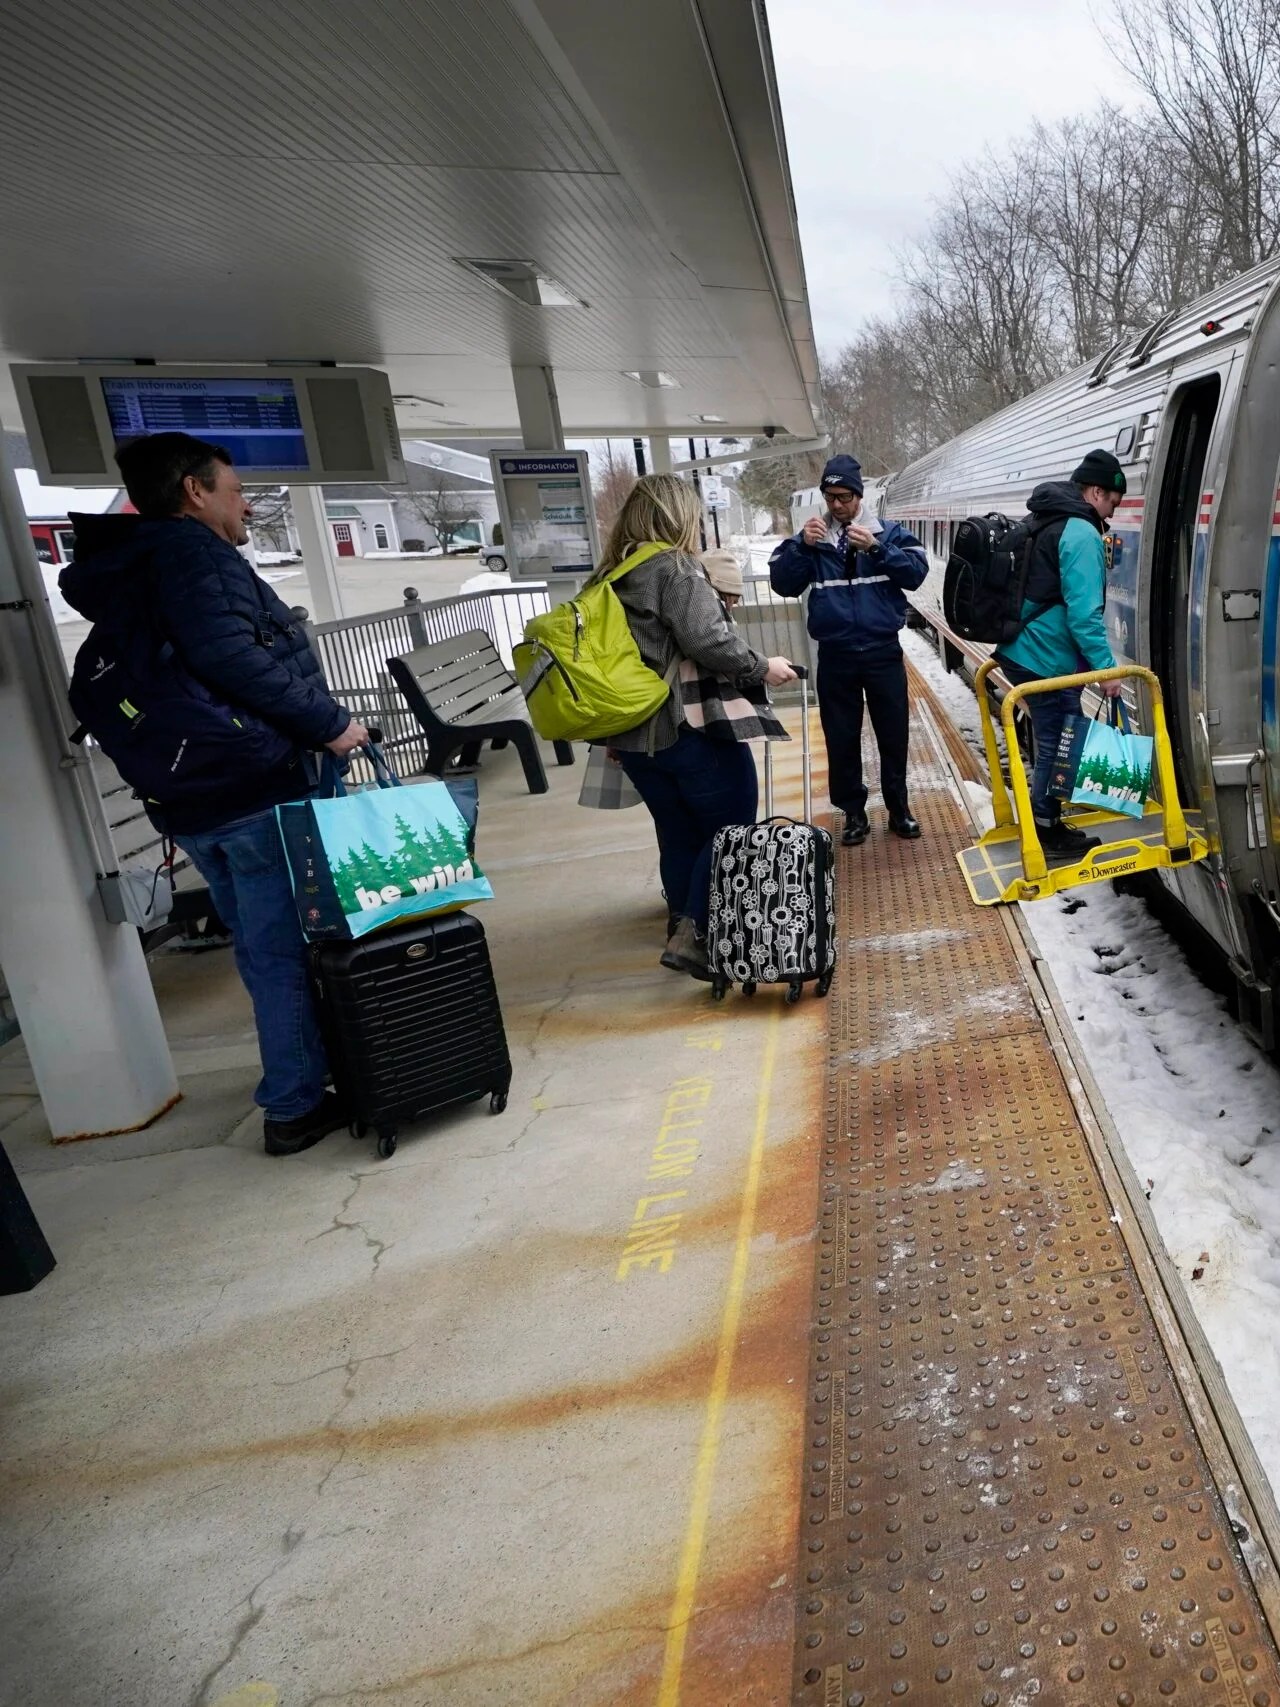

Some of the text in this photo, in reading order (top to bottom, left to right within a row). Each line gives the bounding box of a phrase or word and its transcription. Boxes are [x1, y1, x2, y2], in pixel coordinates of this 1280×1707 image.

[136, 380, 206, 391] Information
[518, 463, 576, 471] INFORMATION
[1082, 776, 1103, 794] be
[1108, 784, 1142, 803] wild
[354, 859, 475, 911] be wild
[1092, 859, 1137, 879] Downeaster
[647, 1077, 715, 1180] YELLOW
[616, 1190, 688, 1281] LINE
[1210, 1624, 1245, 1707] ADE IN USA
